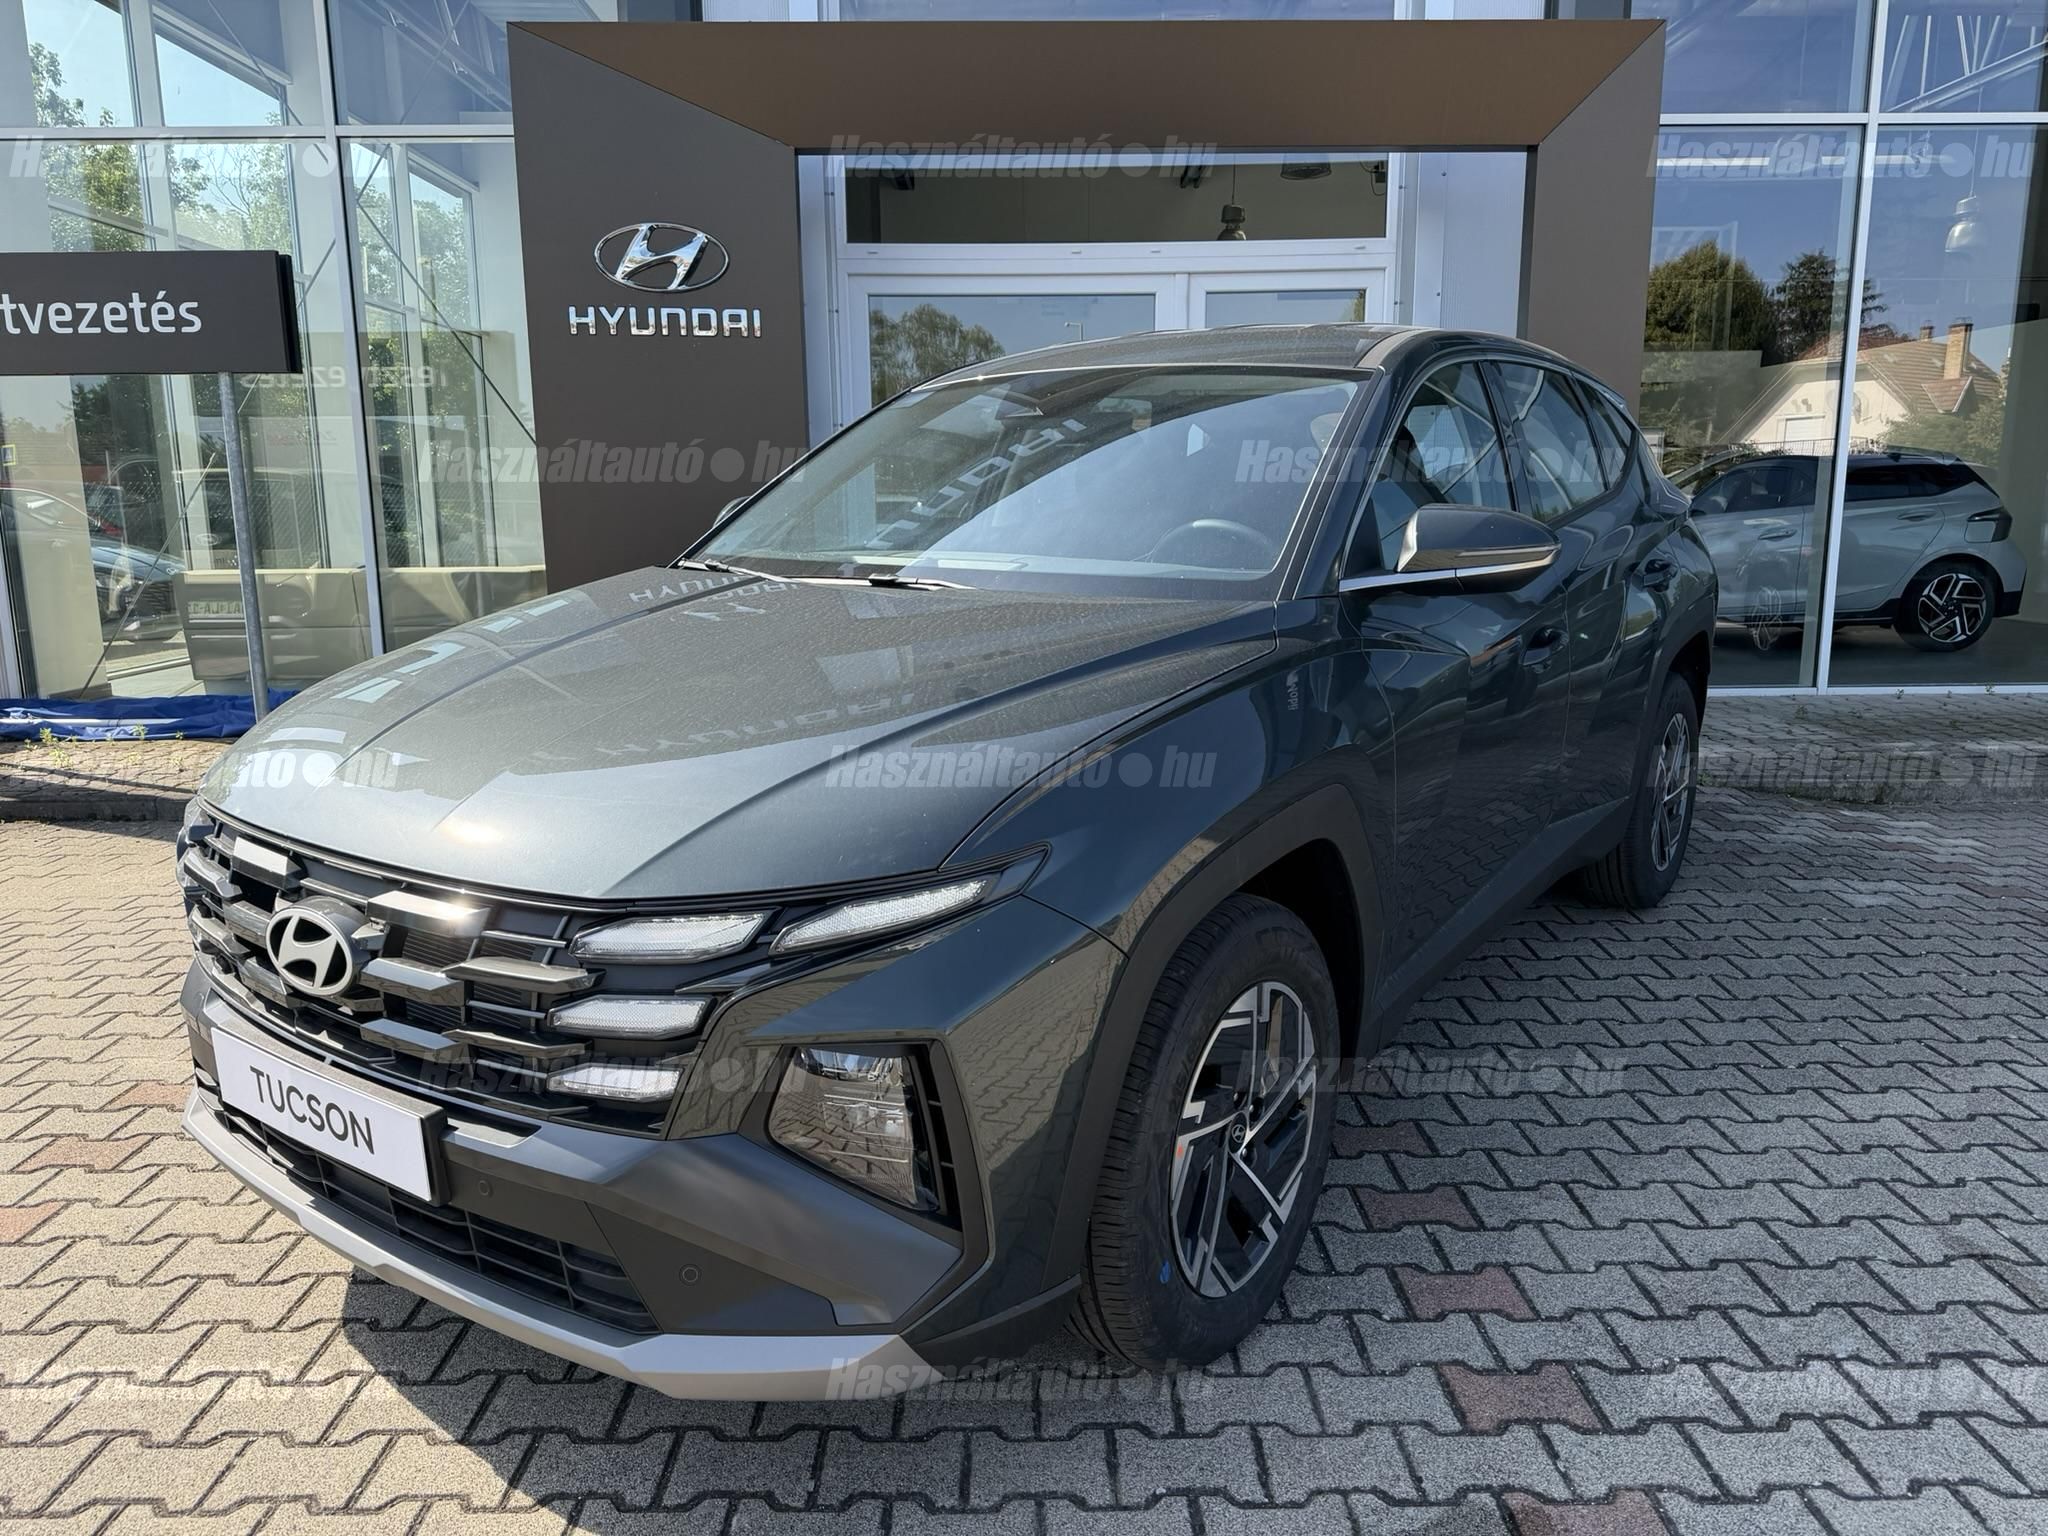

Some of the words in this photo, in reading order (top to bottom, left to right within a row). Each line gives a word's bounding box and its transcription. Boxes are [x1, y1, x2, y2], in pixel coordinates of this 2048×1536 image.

[0, 290, 202, 334] tvezetés
[568, 306, 762, 338] HYUNDAI
[249, 1065, 375, 1155] TUCSON
